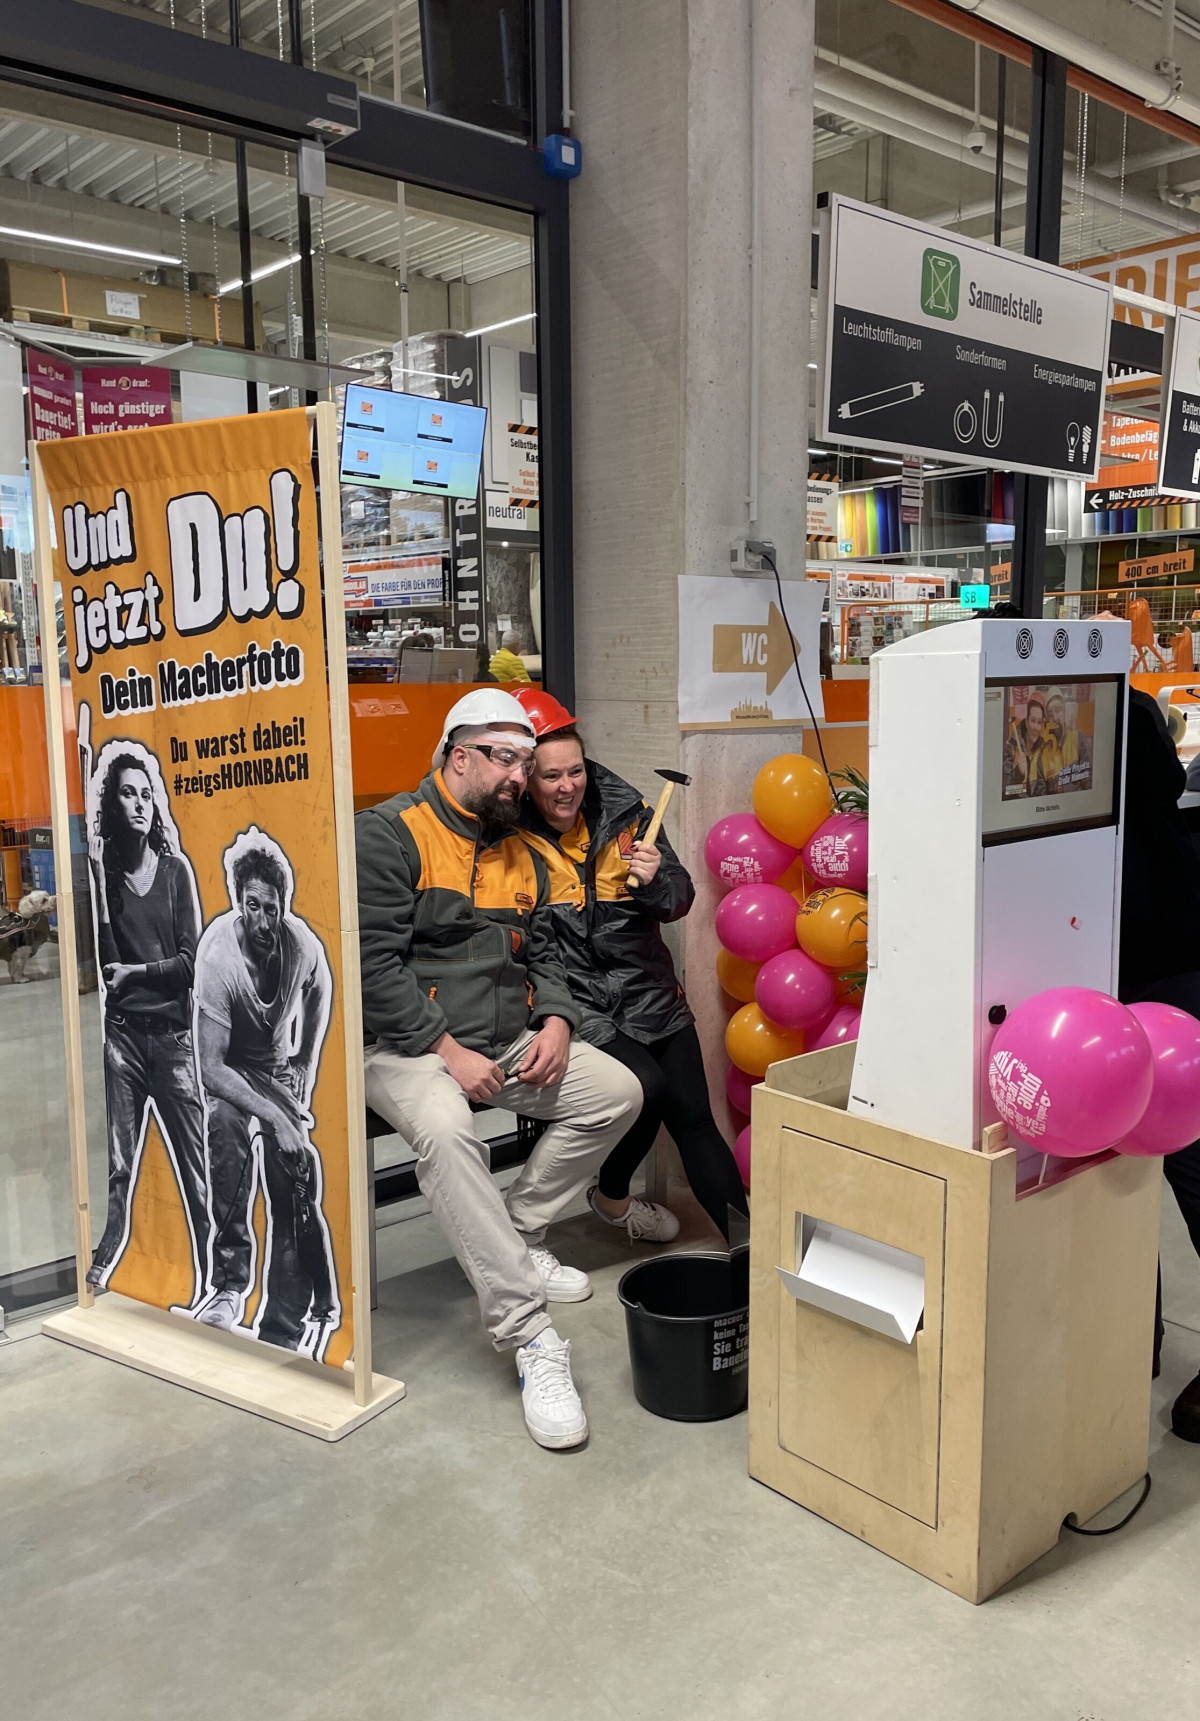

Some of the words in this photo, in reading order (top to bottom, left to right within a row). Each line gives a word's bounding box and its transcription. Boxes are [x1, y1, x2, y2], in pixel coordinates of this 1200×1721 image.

[968, 282, 1042, 326] Sammelstelle
[842, 317, 922, 351] Leuchtstofflampen
[956, 345, 1007, 371] Sonderformen
[1033, 363, 1096, 392] Energiesparlampen
[35, 403, 75, 430] Dauertief-
[90, 402, 114, 414] Noch
[118, 402, 166, 418] günstiger
[1183, 419, 1188, 431] &
[488, 506, 526, 520] neutral
[63, 488, 136, 576] Und
[166, 468, 305, 637] Du!
[1126, 566, 1142, 578] 400
[1146, 565, 1158, 576] cm
[1163, 558, 1186, 572] breit
[371, 582, 381, 593] DIE
[382, 580, 400, 593] FARBE
[400, 578, 412, 591] FÜR
[413, 580, 426, 590] DEN
[964, 591, 976, 604] SB
[72, 572, 166, 674] jetzt
[742, 632, 768, 666] WC
[99, 667, 154, 716] Dein
[157, 639, 302, 706] Macherfoto
[170, 737, 188, 764] Du
[194, 727, 247, 760] warst
[252, 716, 306, 752] dabei!
[174, 752, 310, 798] #zeigsHORNBACH
[714, 1328, 736, 1340] keine
[714, 1342, 732, 1355] Sie
